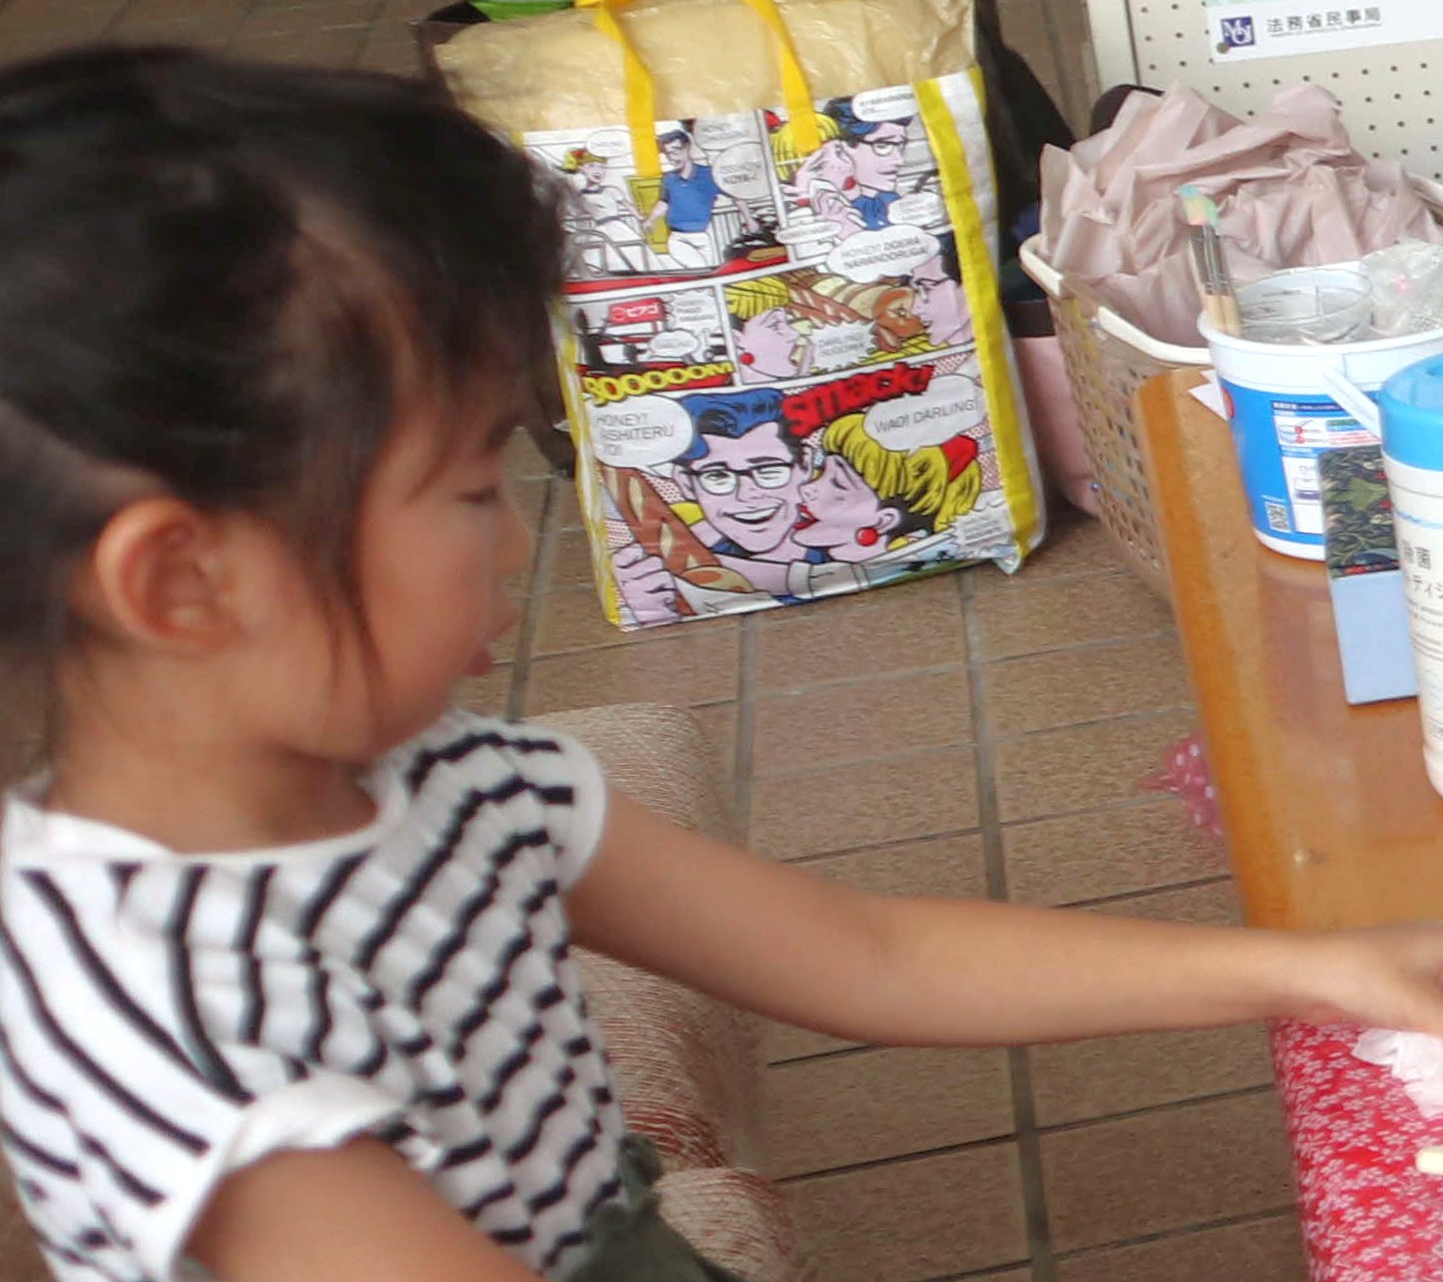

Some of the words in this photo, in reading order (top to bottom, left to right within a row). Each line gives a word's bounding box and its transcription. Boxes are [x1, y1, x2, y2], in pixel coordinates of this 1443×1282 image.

[1267, 7, 1382, 33] 法務省民事局
